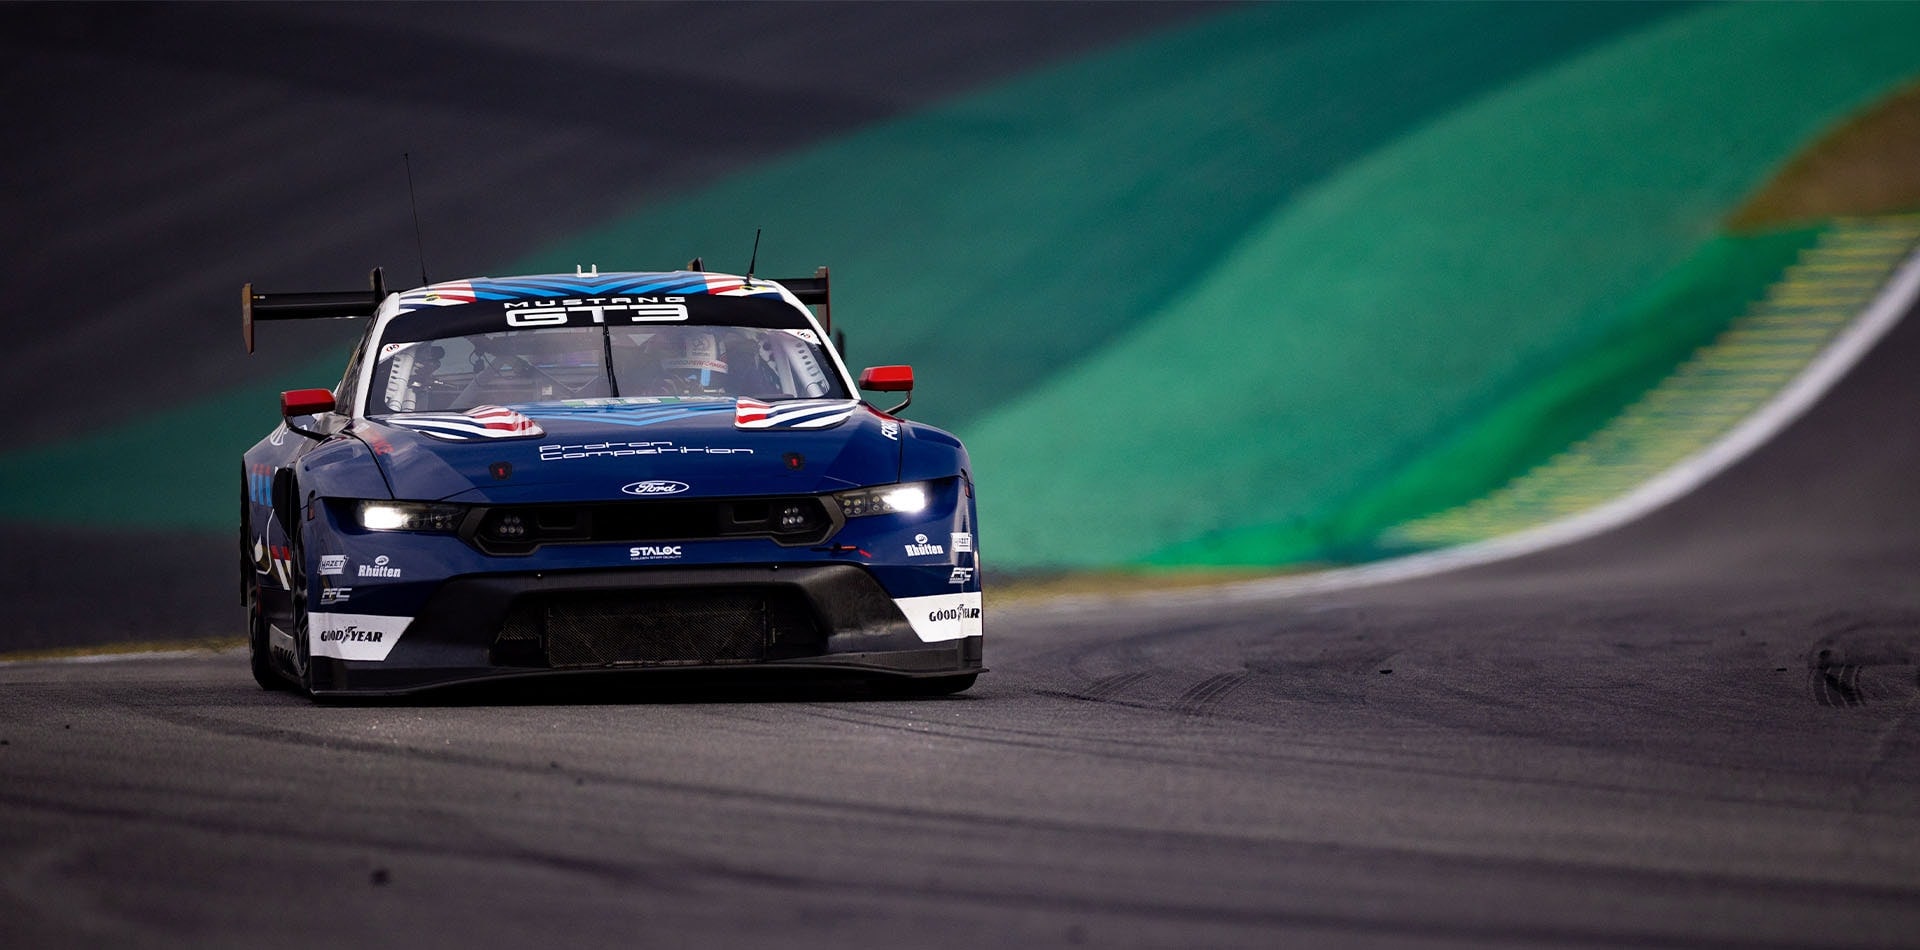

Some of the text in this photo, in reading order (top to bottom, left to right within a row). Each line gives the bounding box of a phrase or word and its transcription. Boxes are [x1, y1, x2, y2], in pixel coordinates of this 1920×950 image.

[504, 296, 686, 308] MUSTANG
[506, 304, 689, 327] GT3
[539, 442, 673, 452] Proton
[541, 446, 754, 461] Competition
[635, 482, 676, 492] Ford
[630, 546, 682, 556] STALOC
[905, 544, 944, 557] Rhütten
[321, 560, 345, 568] HAZET
[358, 564, 401, 578] Rhütten
[950, 567, 974, 578] PFC
[321, 588, 353, 599] PFC
[321, 626, 383, 643] GOODYEAR
